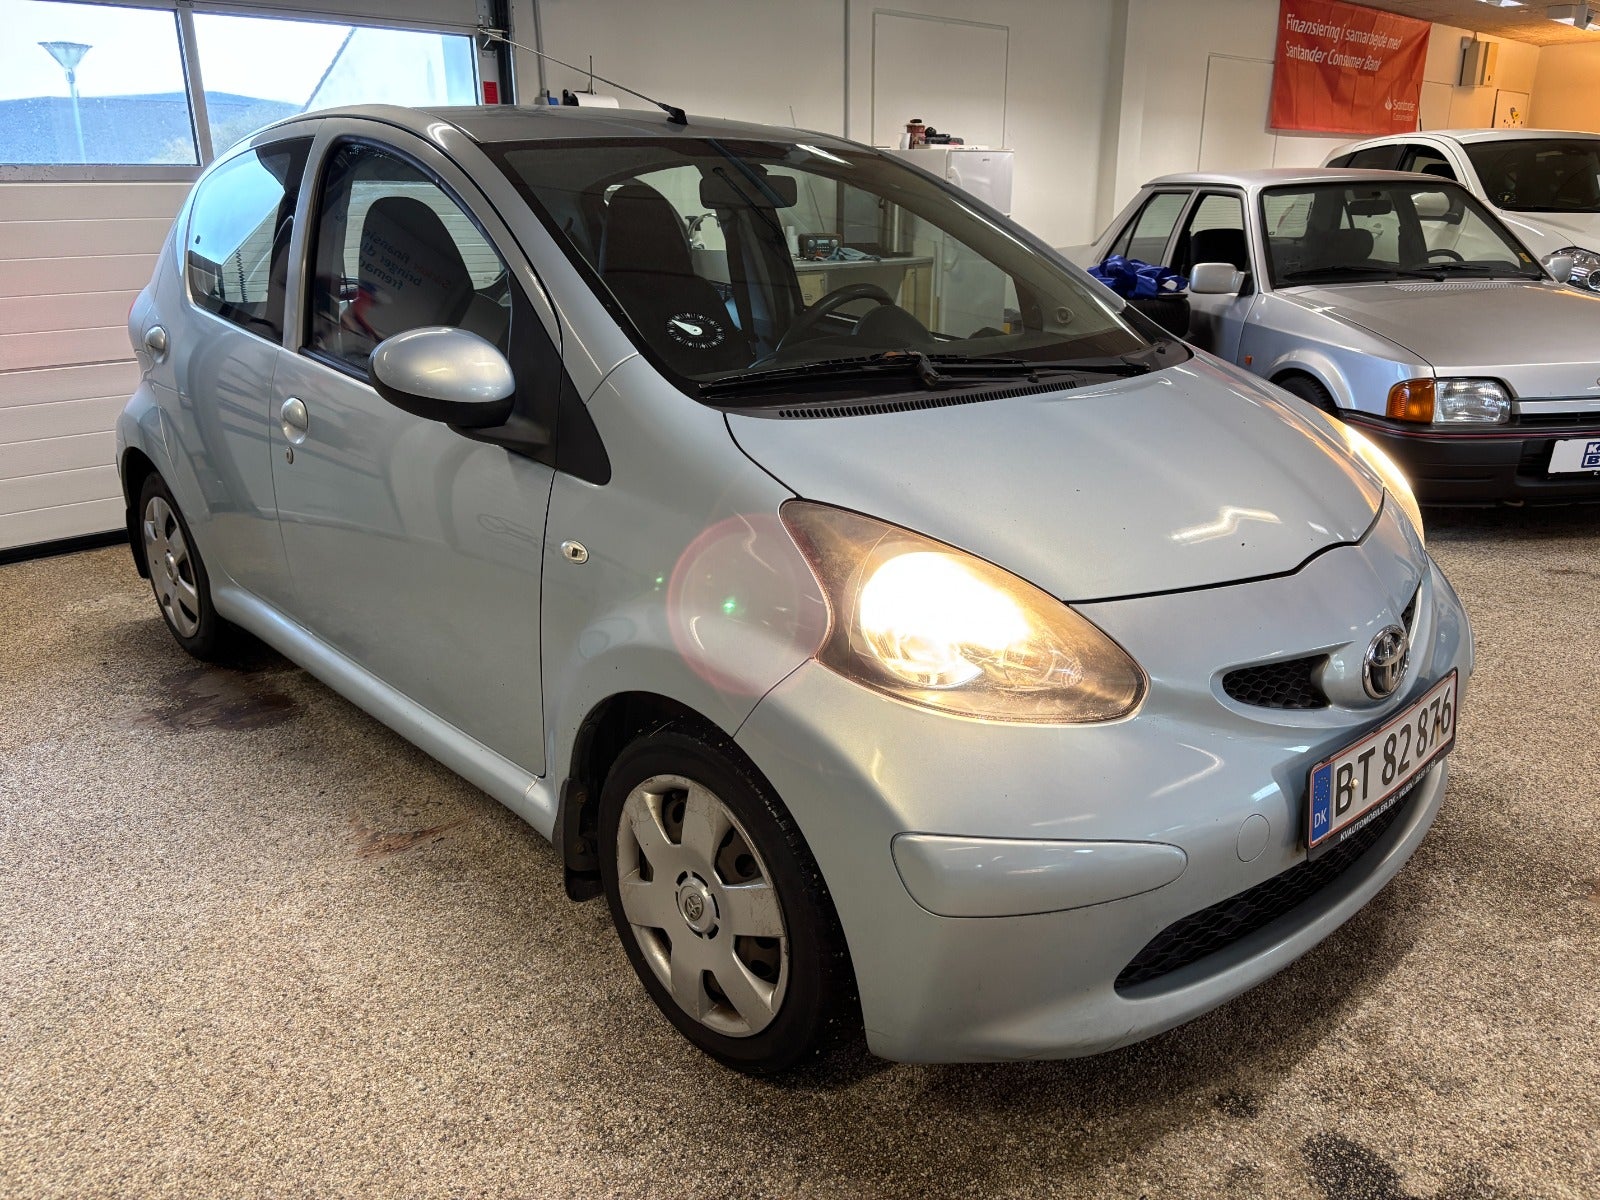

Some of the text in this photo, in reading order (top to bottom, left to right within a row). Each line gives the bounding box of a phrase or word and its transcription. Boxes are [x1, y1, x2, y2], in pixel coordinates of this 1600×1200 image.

[1286, 13, 1403, 51] Finansiering i samarbejde med
[1286, 40, 1382, 71] Santander Consumer Bank
[1335, 684, 1451, 817] BT 82 876
[1314, 808, 1327, 829] DK
